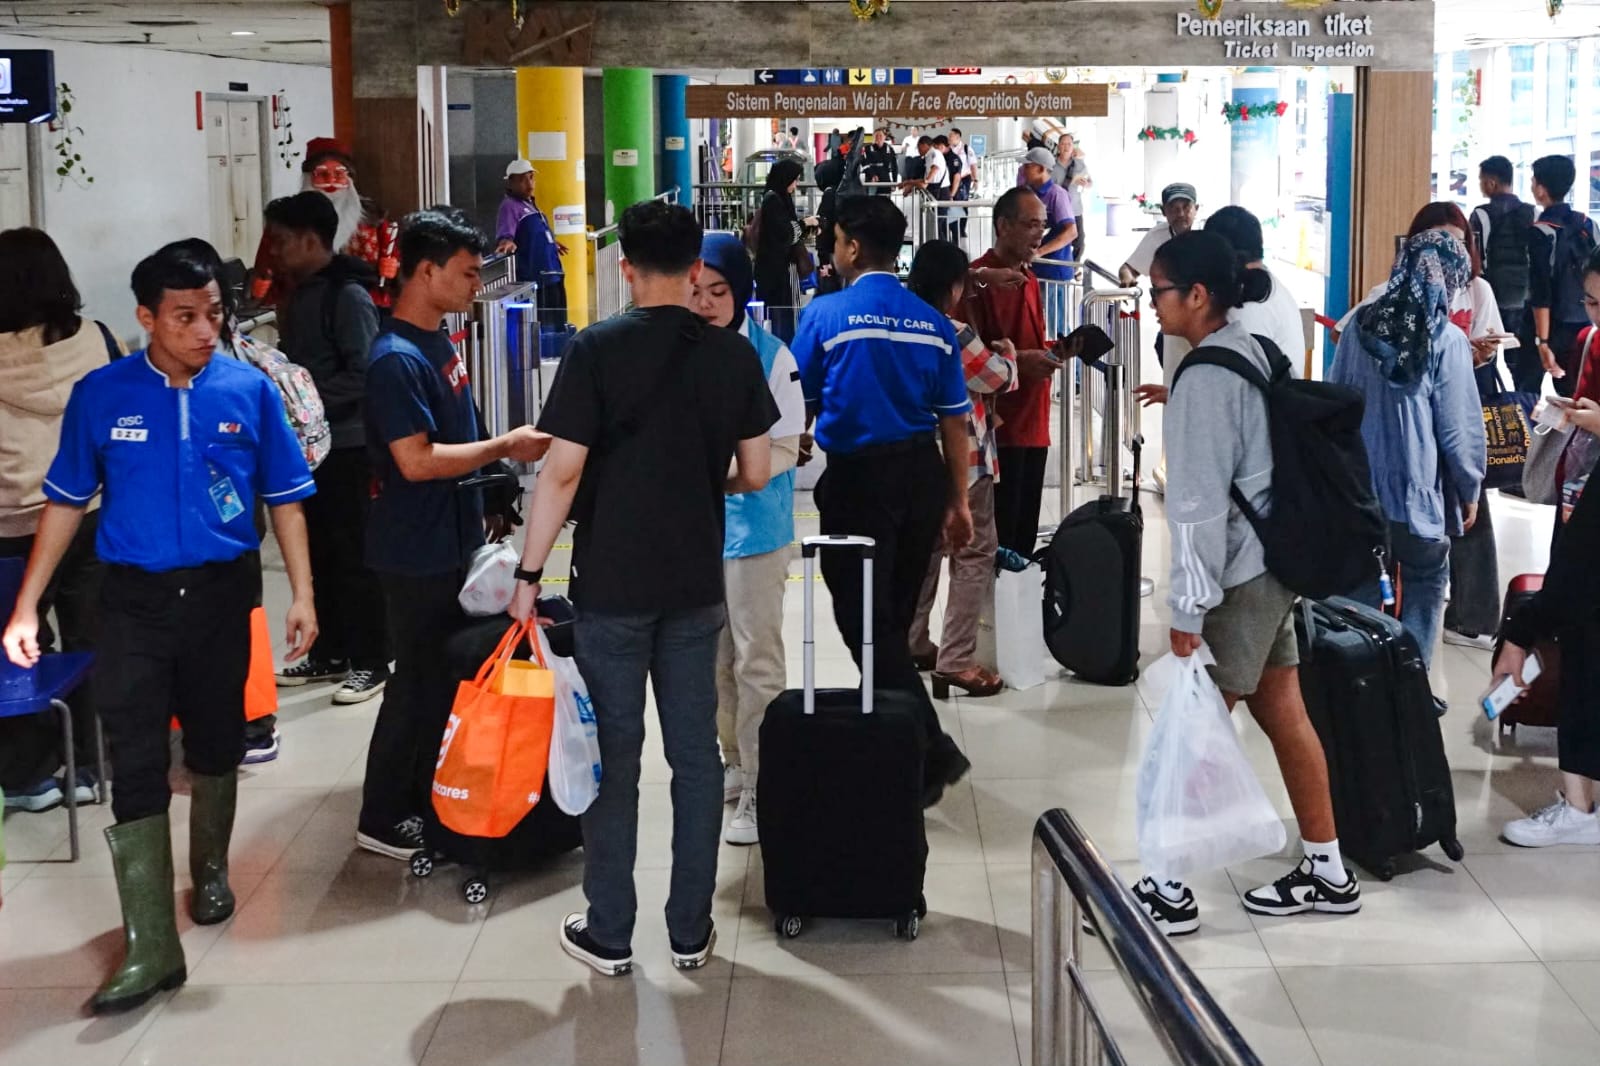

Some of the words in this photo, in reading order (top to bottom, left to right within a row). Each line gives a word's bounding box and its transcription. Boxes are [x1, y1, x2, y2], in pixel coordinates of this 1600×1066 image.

[1176, 12, 1311, 37] Pemeriksaan
[1324, 12, 1373, 36] tiket
[1224, 41, 1279, 58] Ticket
[1291, 41, 1374, 61] Inspection
[726, 91, 770, 111] Sistem
[774, 91, 847, 115] Pengenalan
[852, 91, 893, 116] Wajah
[910, 91, 941, 111] Face
[946, 91, 1020, 114] Recognition
[1024, 91, 1072, 114] System
[848, 314, 900, 327] FACILITY
[904, 319, 936, 331] CARE
[117, 415, 144, 427] OSC
[1487, 455, 1526, 465] Donald's
